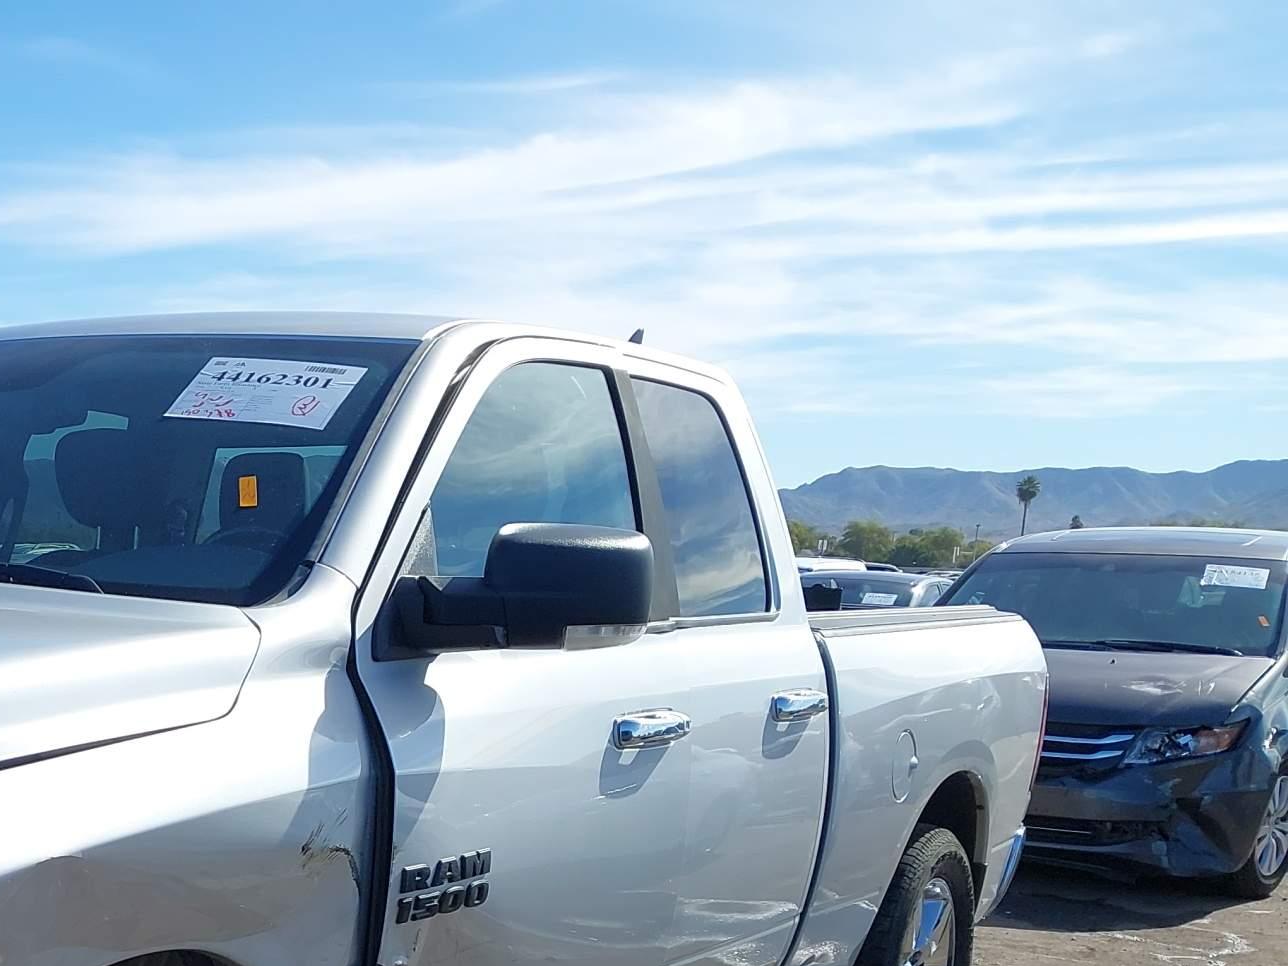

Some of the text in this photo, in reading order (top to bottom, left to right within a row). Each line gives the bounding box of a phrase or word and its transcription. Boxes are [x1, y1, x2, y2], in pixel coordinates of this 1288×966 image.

[212, 371, 334, 389] 44162301
[399, 847, 491, 894] RAM
[396, 879, 489, 924] 1500
